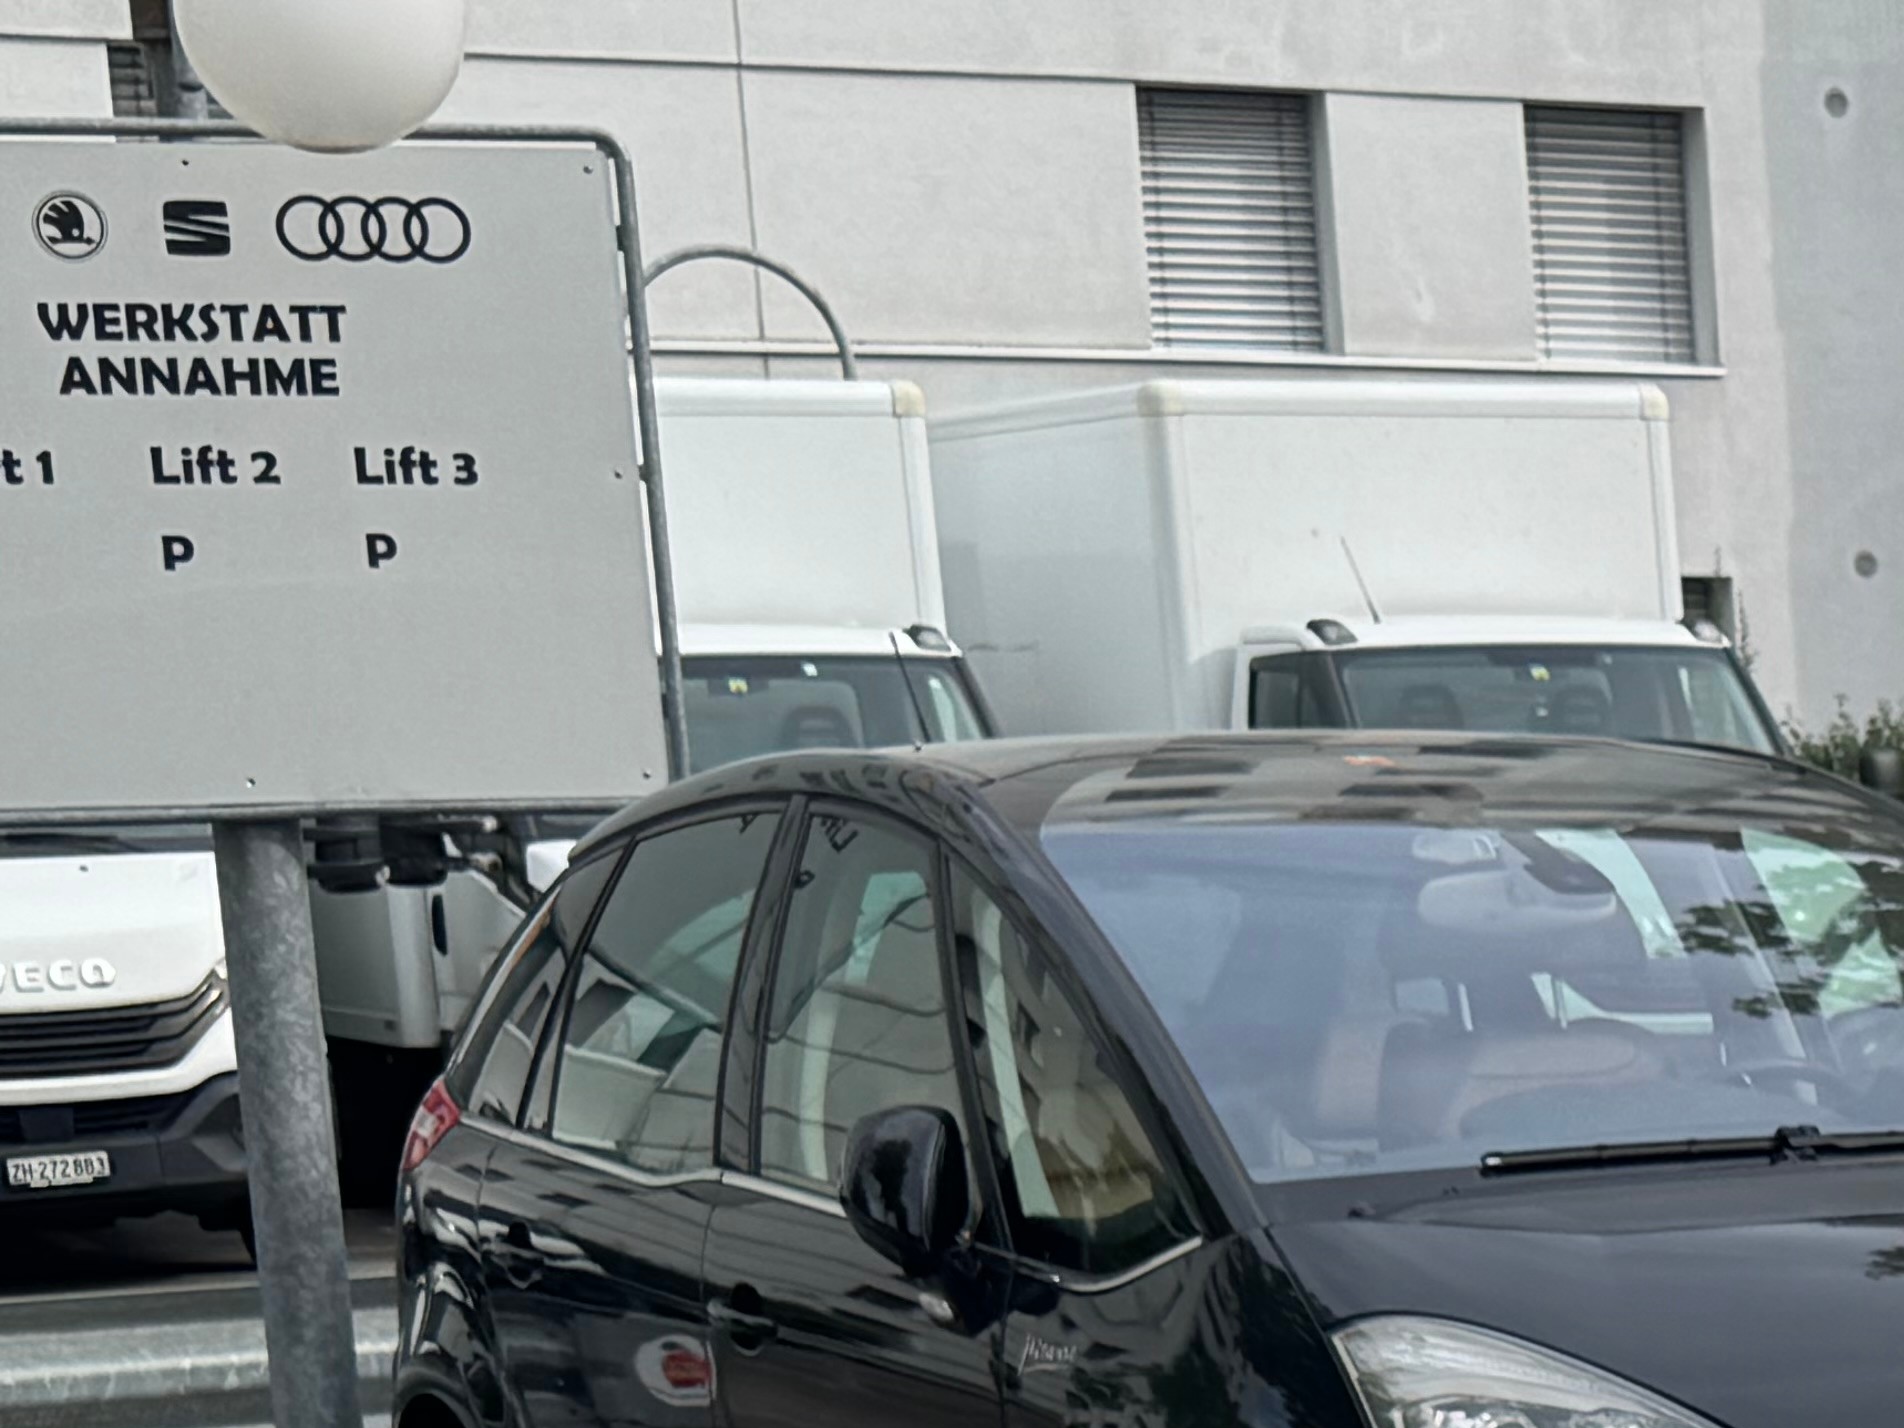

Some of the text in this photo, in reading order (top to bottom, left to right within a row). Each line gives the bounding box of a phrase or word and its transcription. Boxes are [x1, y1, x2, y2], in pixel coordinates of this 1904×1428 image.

[37, 303, 346, 342] WERKSTATT
[60, 357, 339, 396] ANNAHME
[36, 451, 53, 484] 1
[150, 445, 280, 484] Lift 2
[354, 446, 477, 485] Lift 3
[162, 536, 194, 570] P
[366, 534, 396, 568] P
